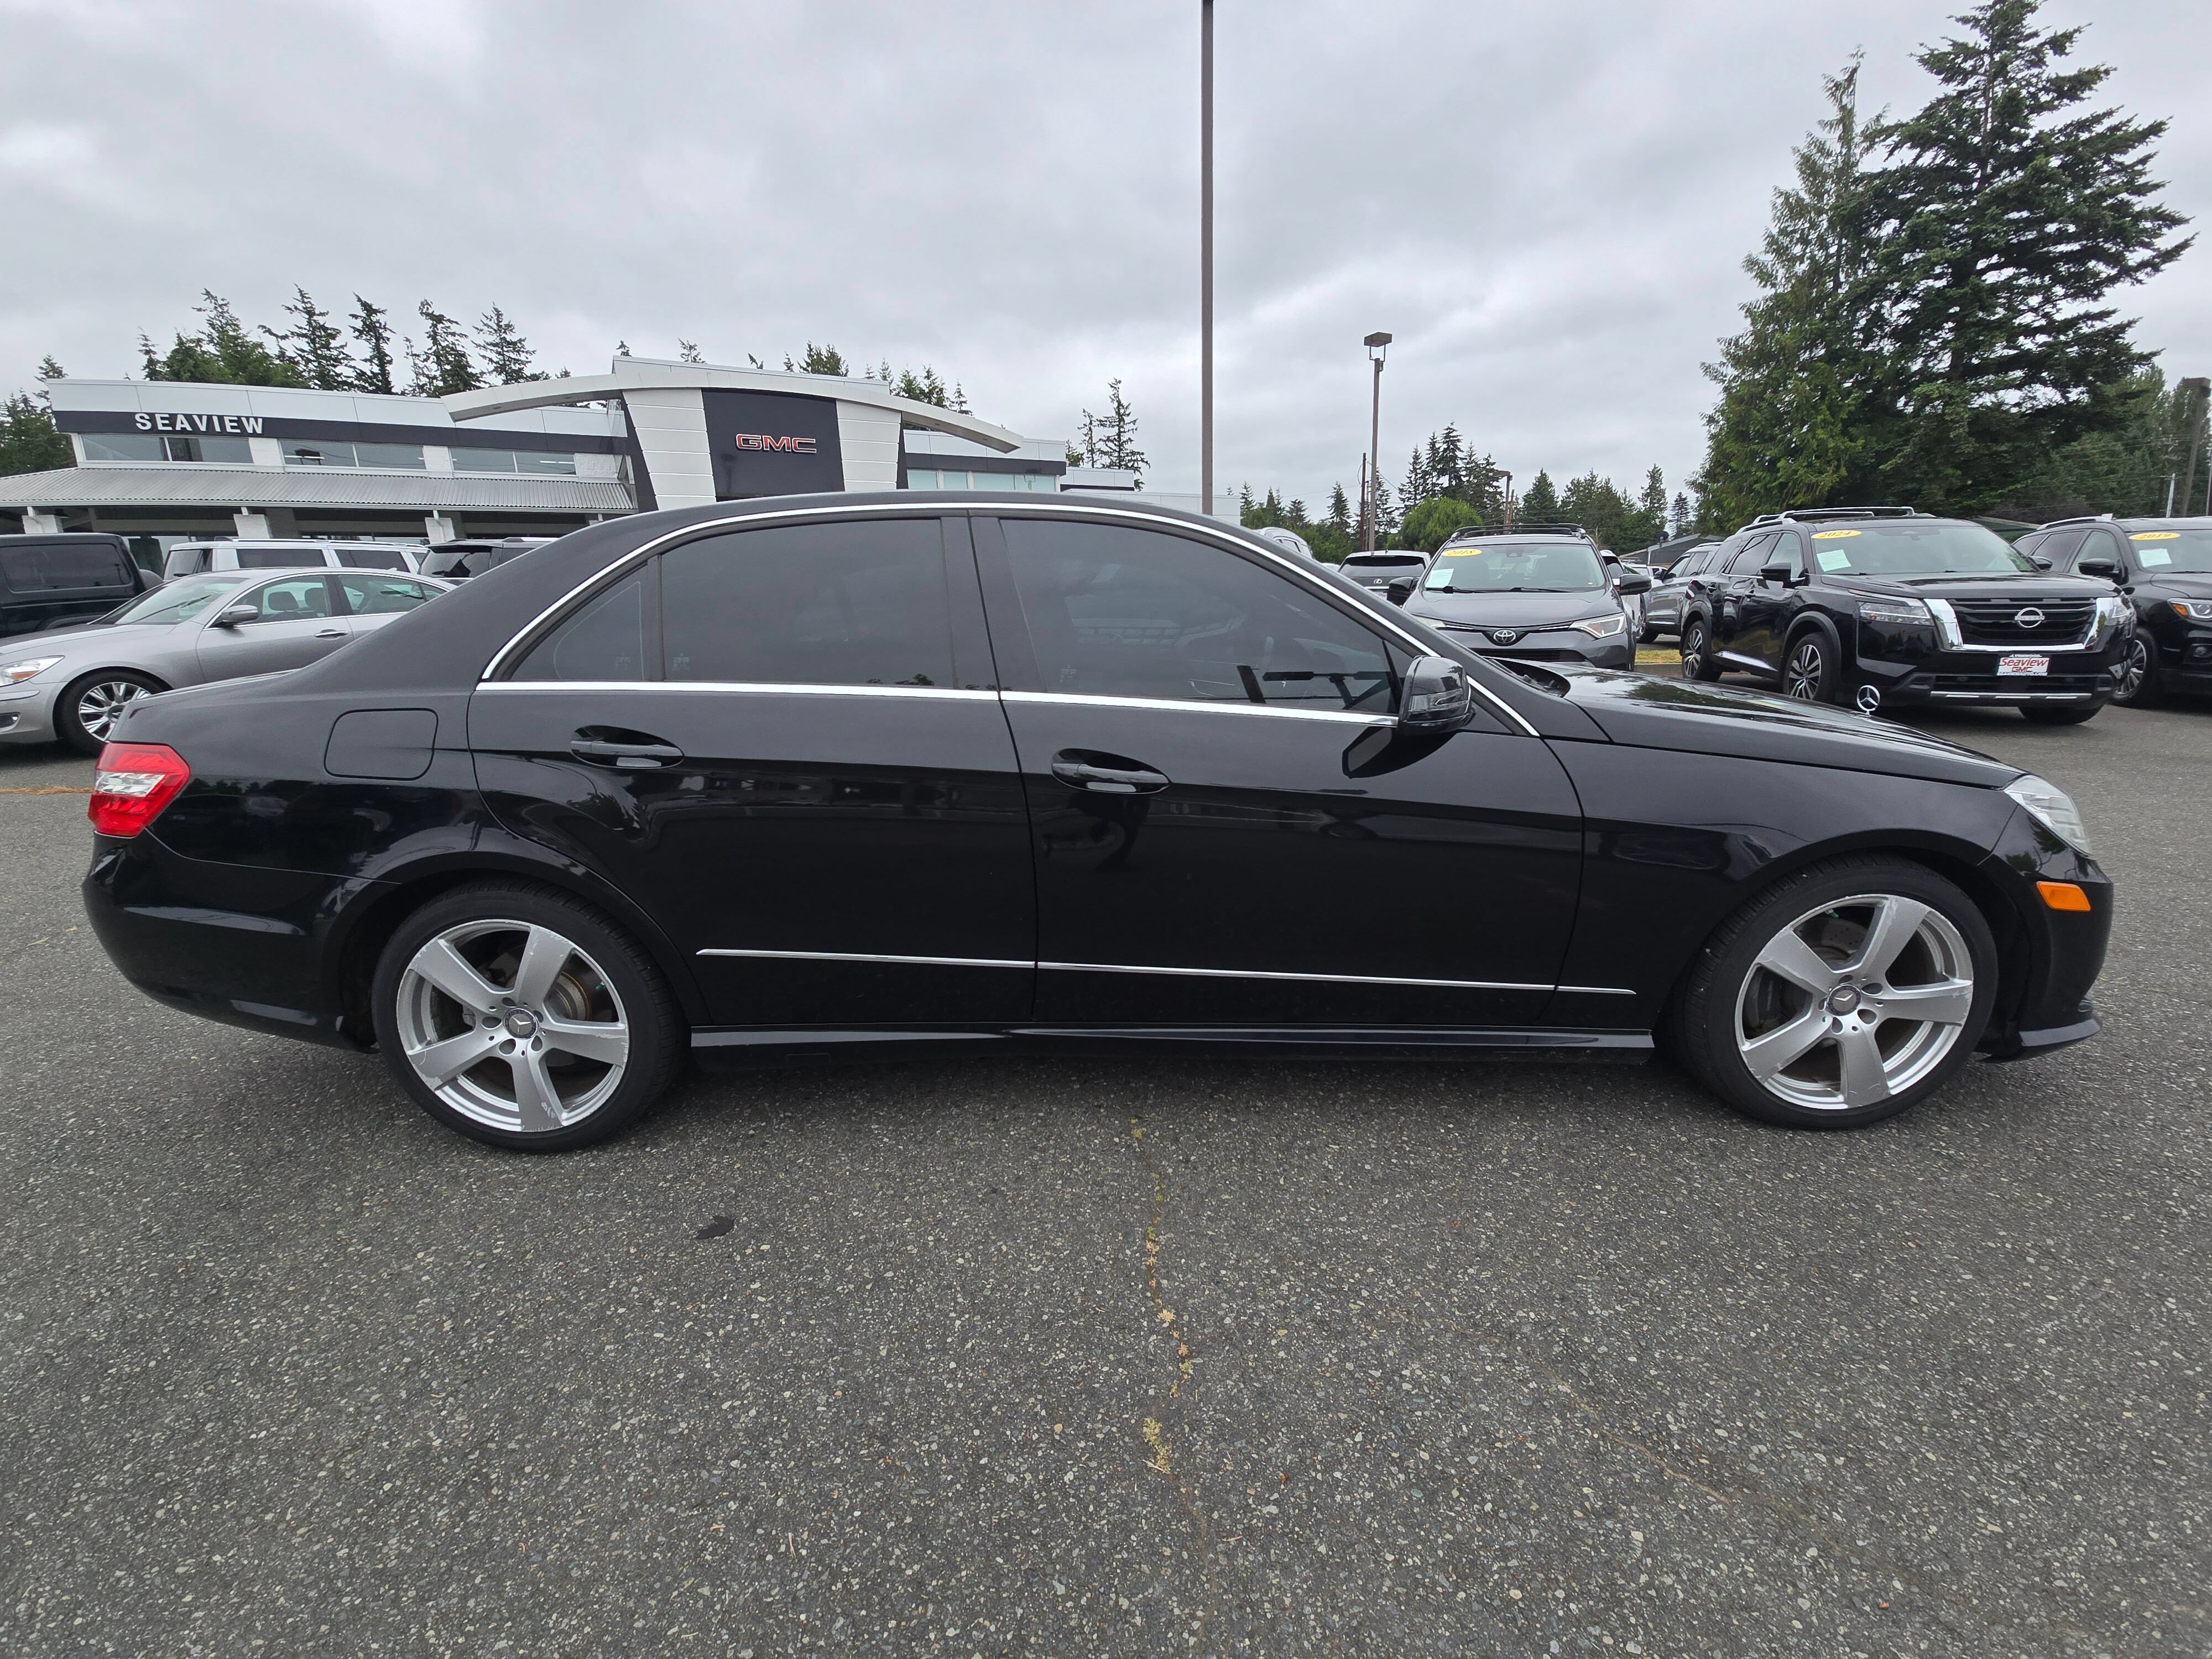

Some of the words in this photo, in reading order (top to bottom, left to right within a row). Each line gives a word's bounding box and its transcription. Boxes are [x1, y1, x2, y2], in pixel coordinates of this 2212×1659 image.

[134, 413, 263, 434] SEAVIEW
[735, 434, 817, 453] GMC
[2000, 658, 2048, 666] Seaview
